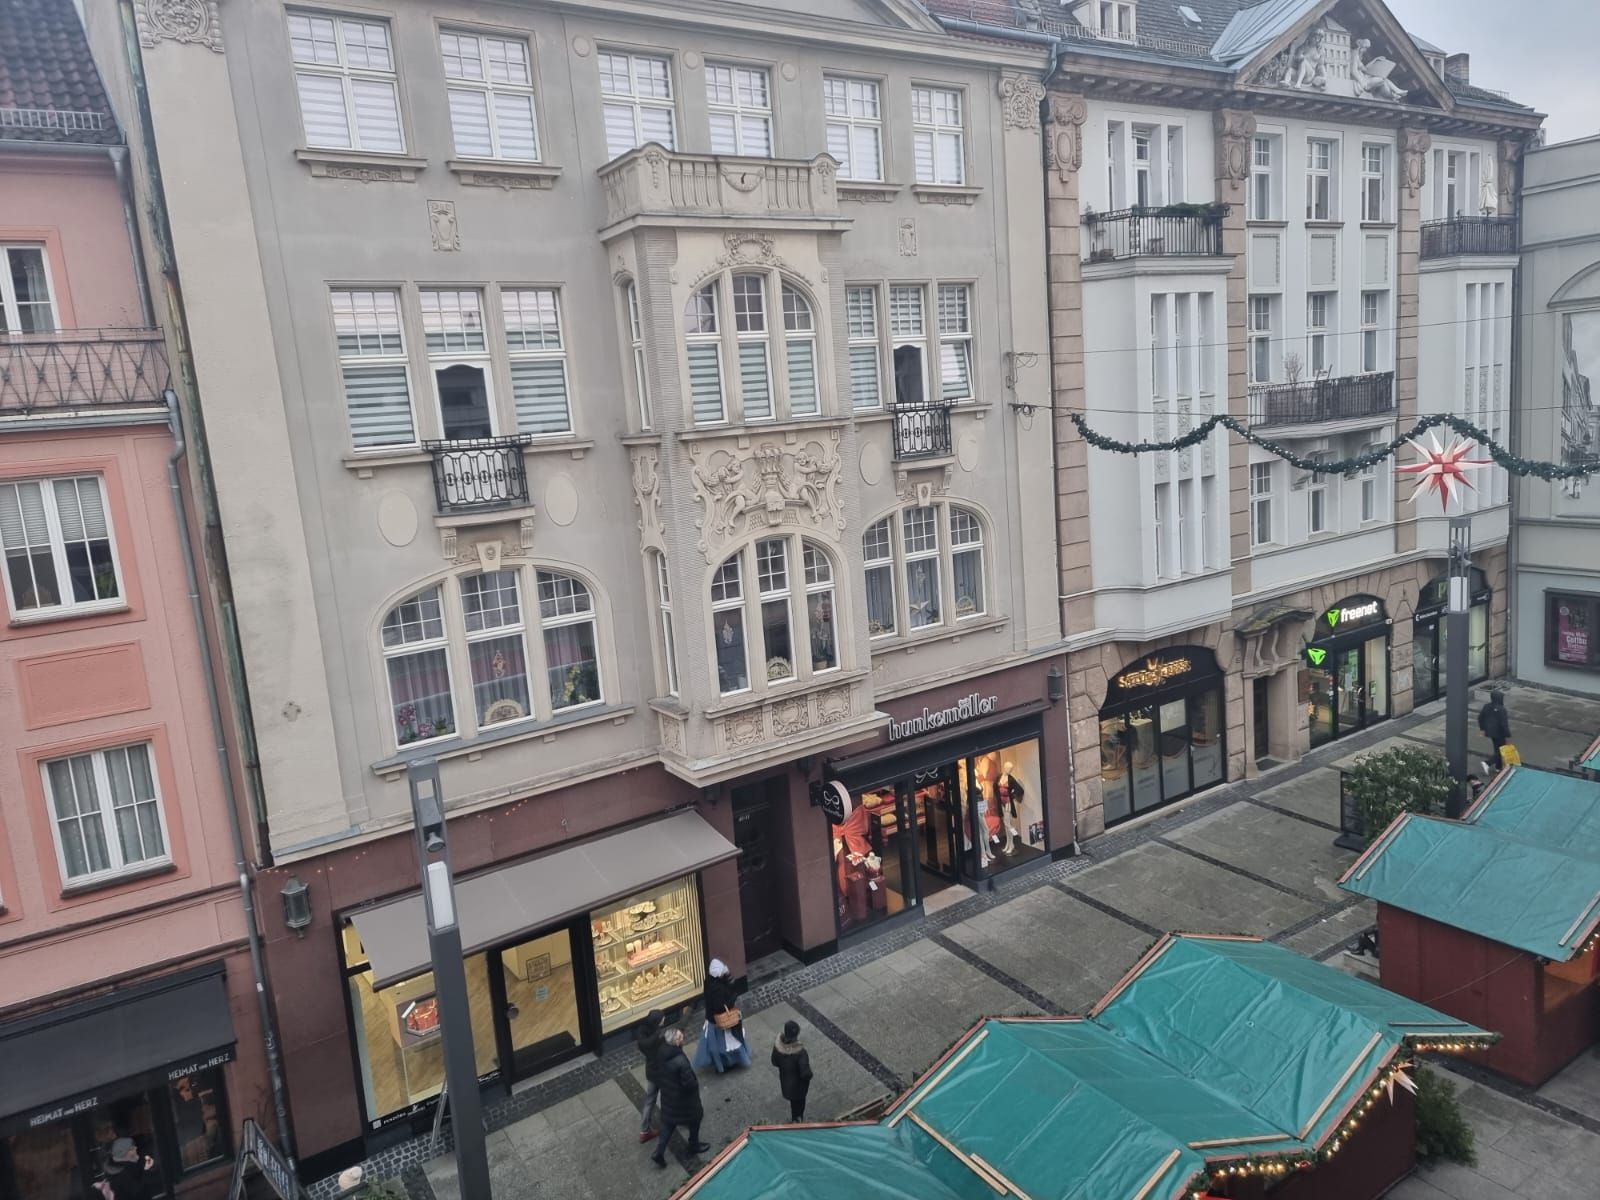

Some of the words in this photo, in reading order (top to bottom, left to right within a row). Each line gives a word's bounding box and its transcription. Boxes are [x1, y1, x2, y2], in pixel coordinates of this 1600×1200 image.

[1341, 600, 1378, 623] freenet
[888, 692, 998, 741] hunkemöller
[168, 1063, 198, 1081] HEIMAT
[208, 1053, 230, 1067] HERZ
[30, 1108, 63, 1128] HEIMAT
[74, 1097, 99, 1113] HERZ
